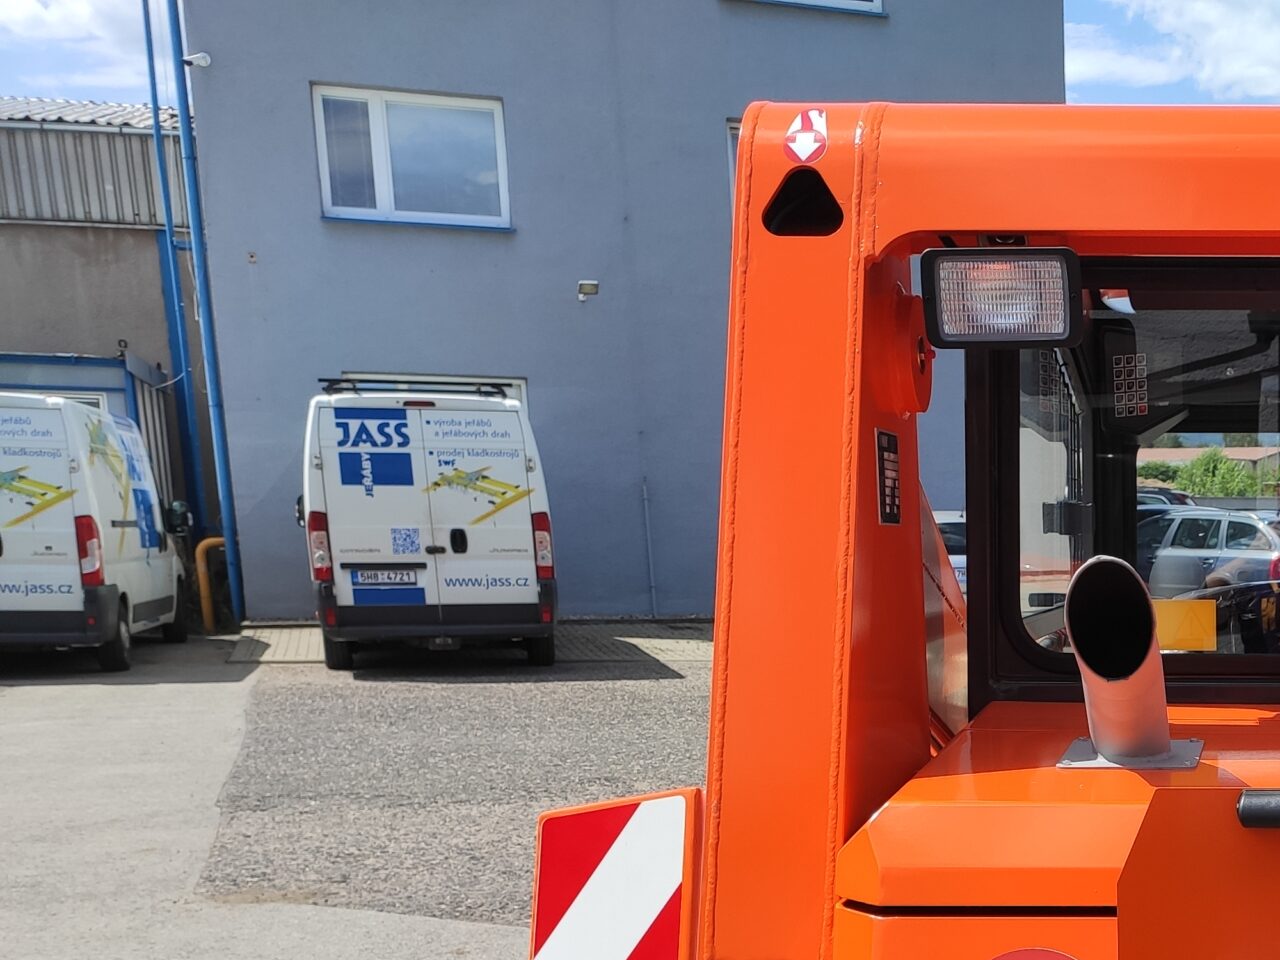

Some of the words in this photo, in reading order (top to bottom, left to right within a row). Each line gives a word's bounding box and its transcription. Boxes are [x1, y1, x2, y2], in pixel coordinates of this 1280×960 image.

[433, 418, 462, 428] výroba
[335, 421, 411, 448] JASS
[436, 449, 465, 459] prodej
[386, 572, 411, 582] 4721
[445, 574, 530, 589] www.jass.cz
